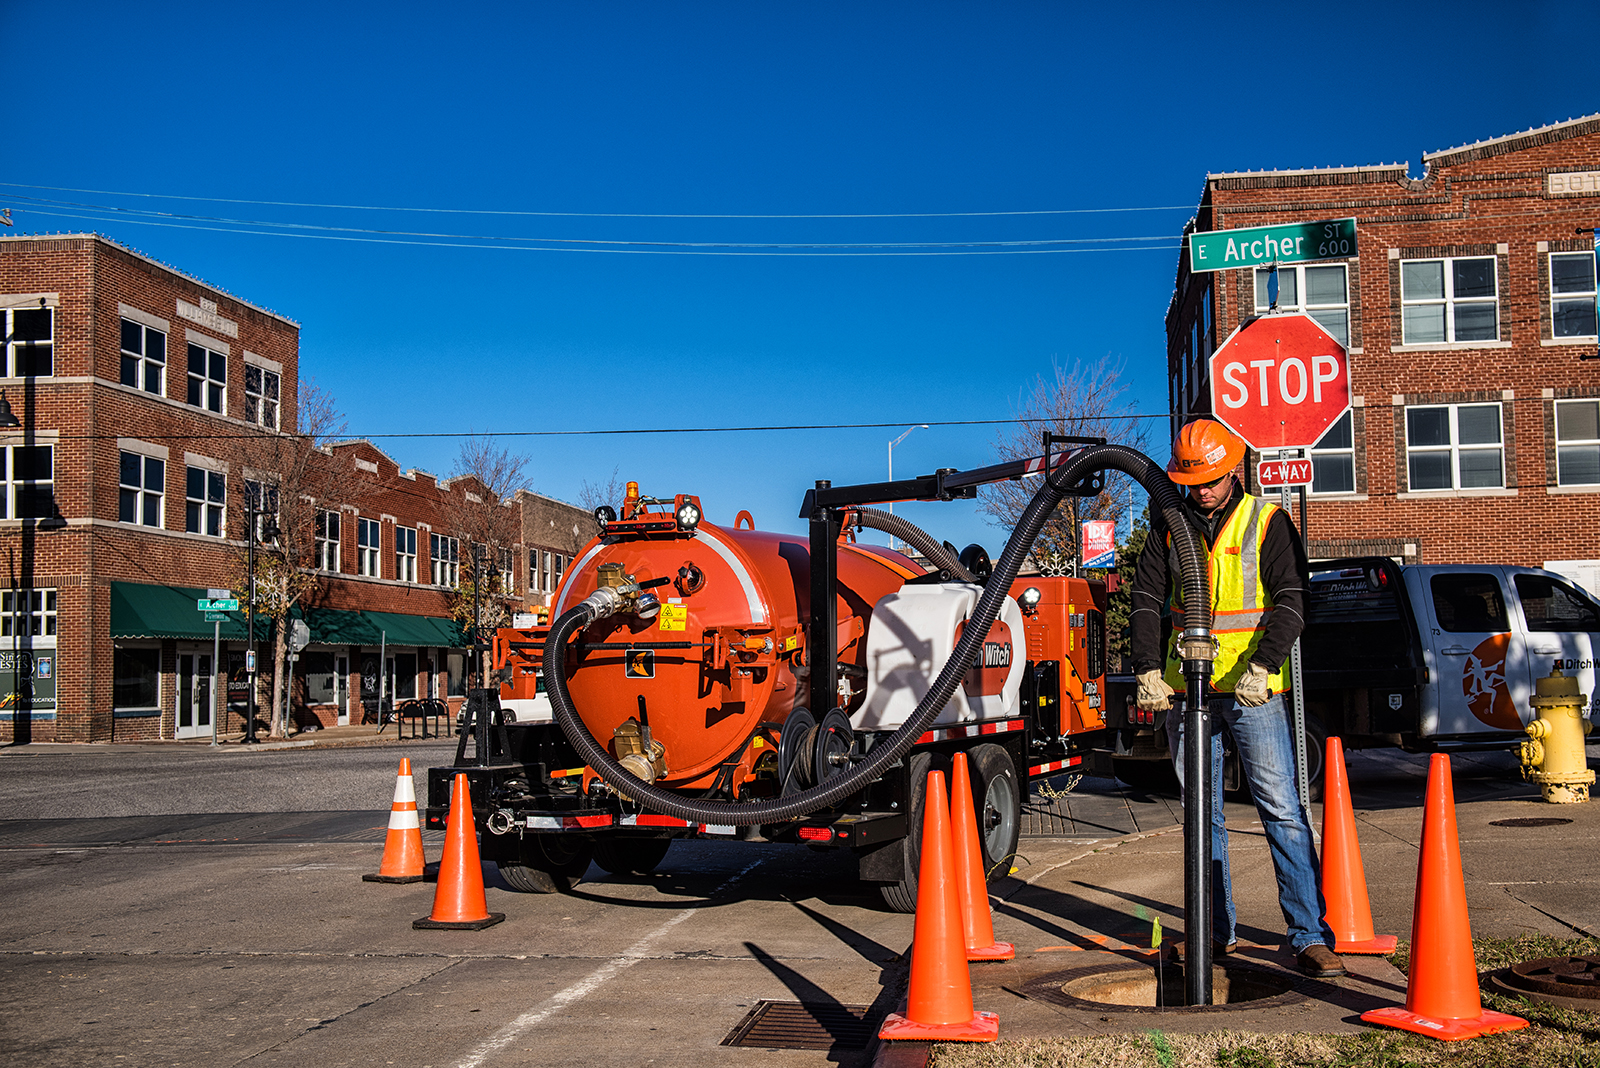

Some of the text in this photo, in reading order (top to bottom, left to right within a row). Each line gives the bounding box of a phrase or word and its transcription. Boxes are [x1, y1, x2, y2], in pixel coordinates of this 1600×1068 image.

[1199, 223, 1341, 262] E Archer ST
[1318, 239, 1349, 256] 600
[1222, 355, 1340, 408] STOP
[1262, 464, 1308, 481] 4-WAY
[1431, 628, 1441, 636] 73
[985, 643, 1010, 667] Witch
[1566, 659, 1591, 670] Ditch
